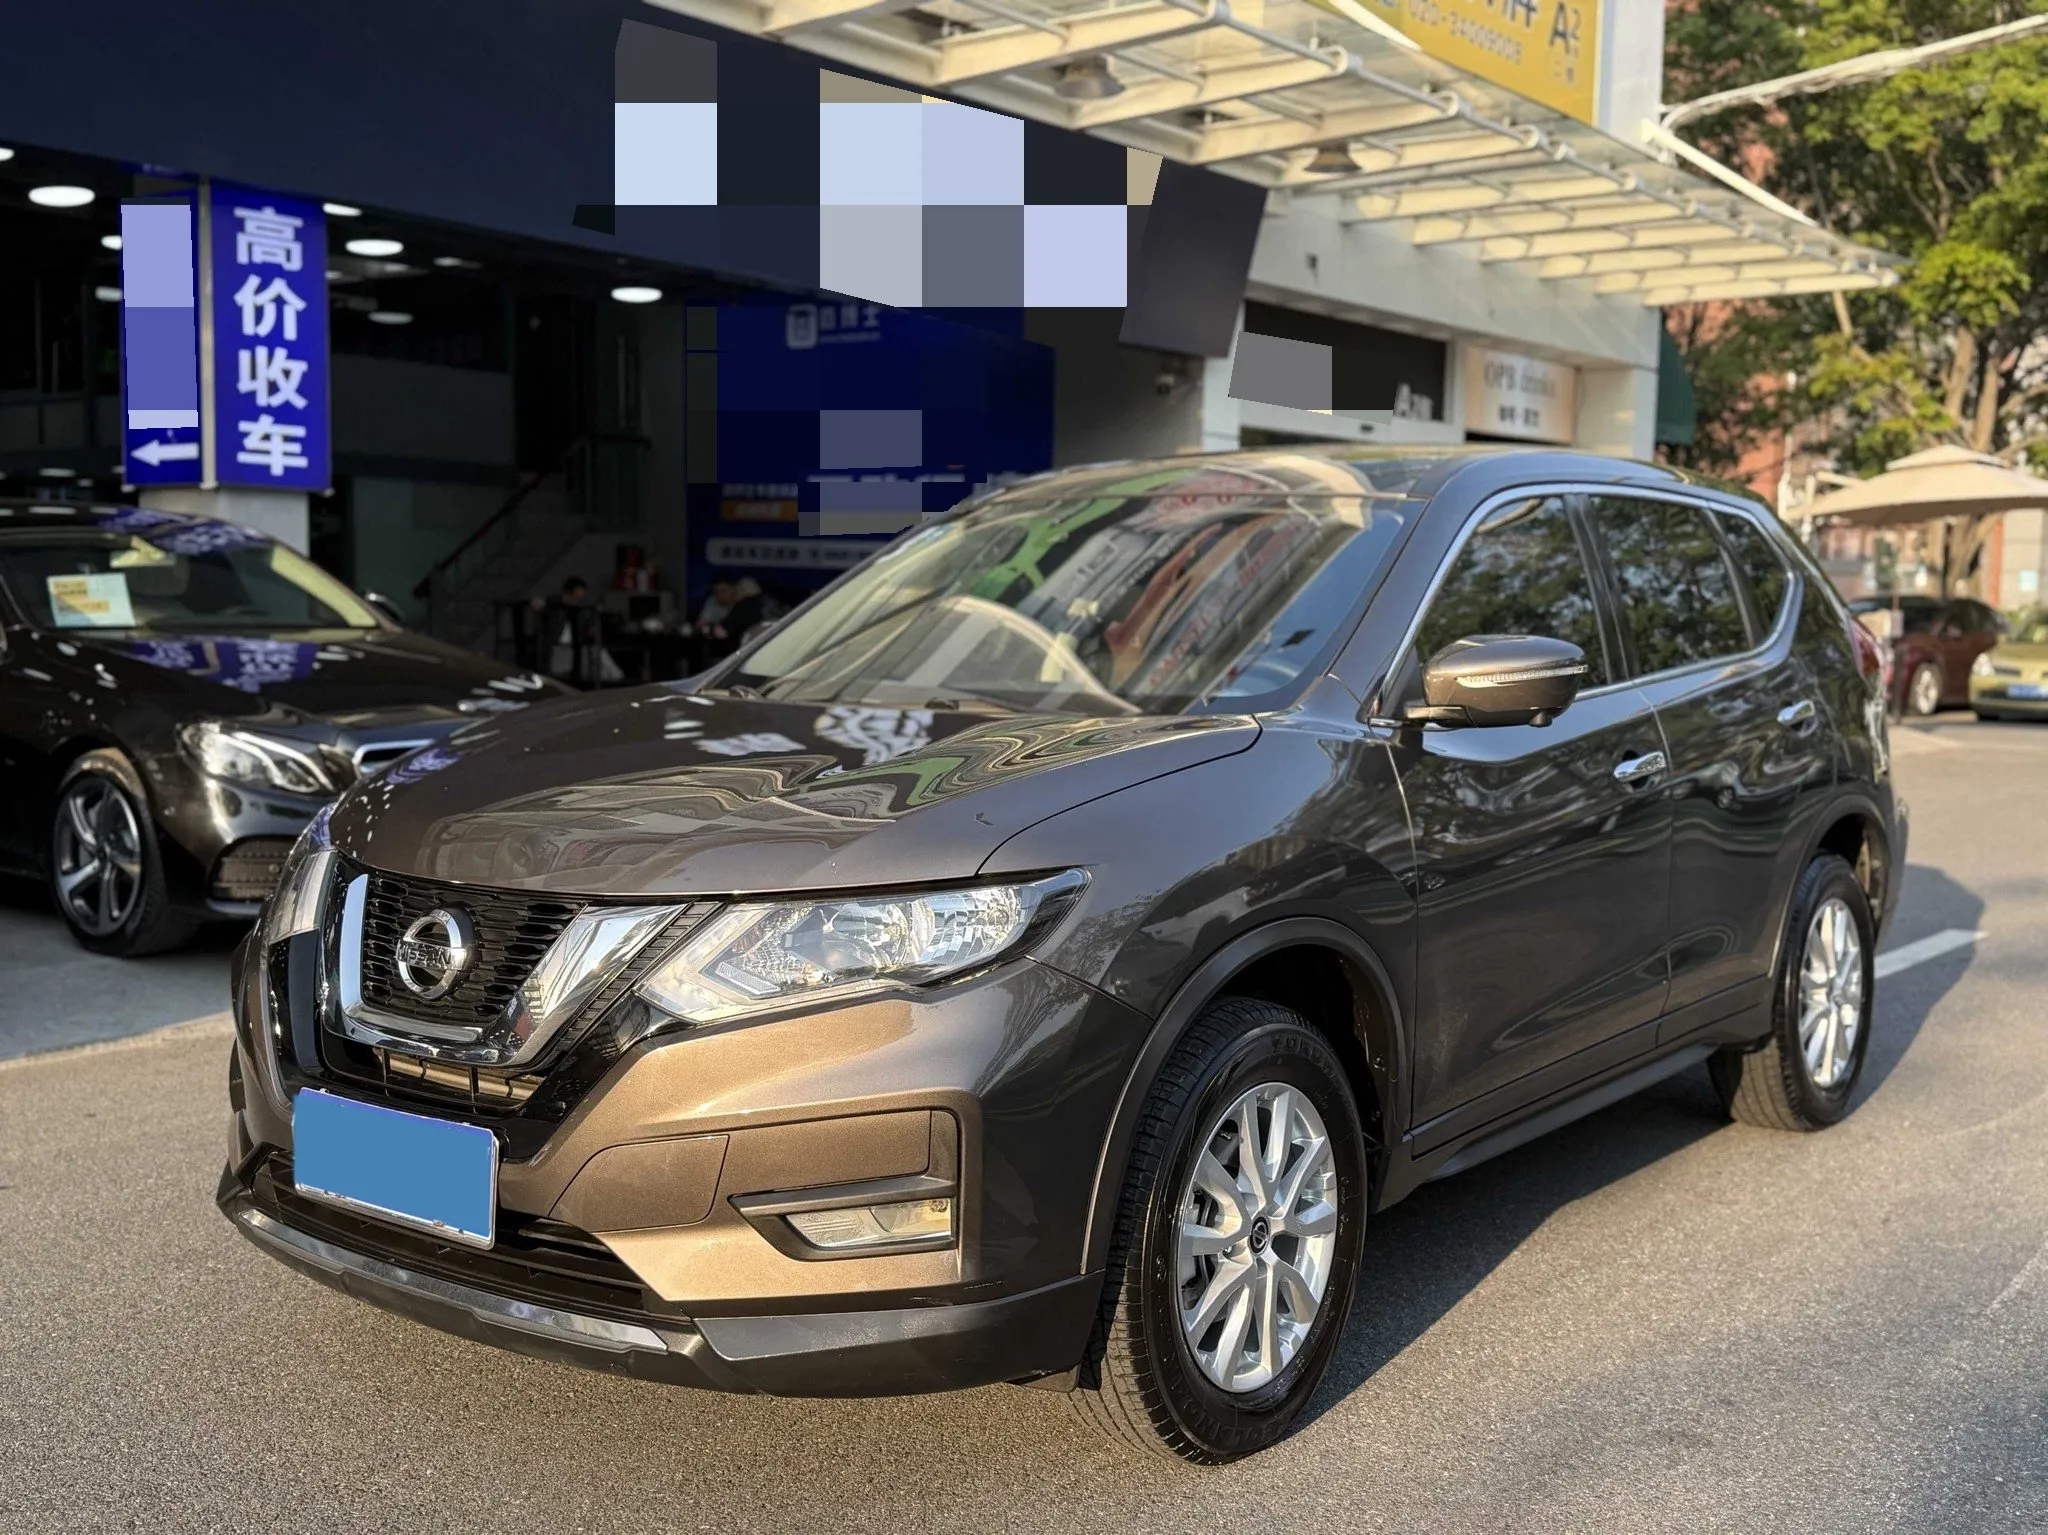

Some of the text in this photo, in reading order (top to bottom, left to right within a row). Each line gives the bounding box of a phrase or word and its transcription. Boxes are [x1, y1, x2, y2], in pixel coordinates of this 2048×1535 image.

[233, 205, 309, 477] 高价收车
[397, 940, 452, 965] NISSAN
